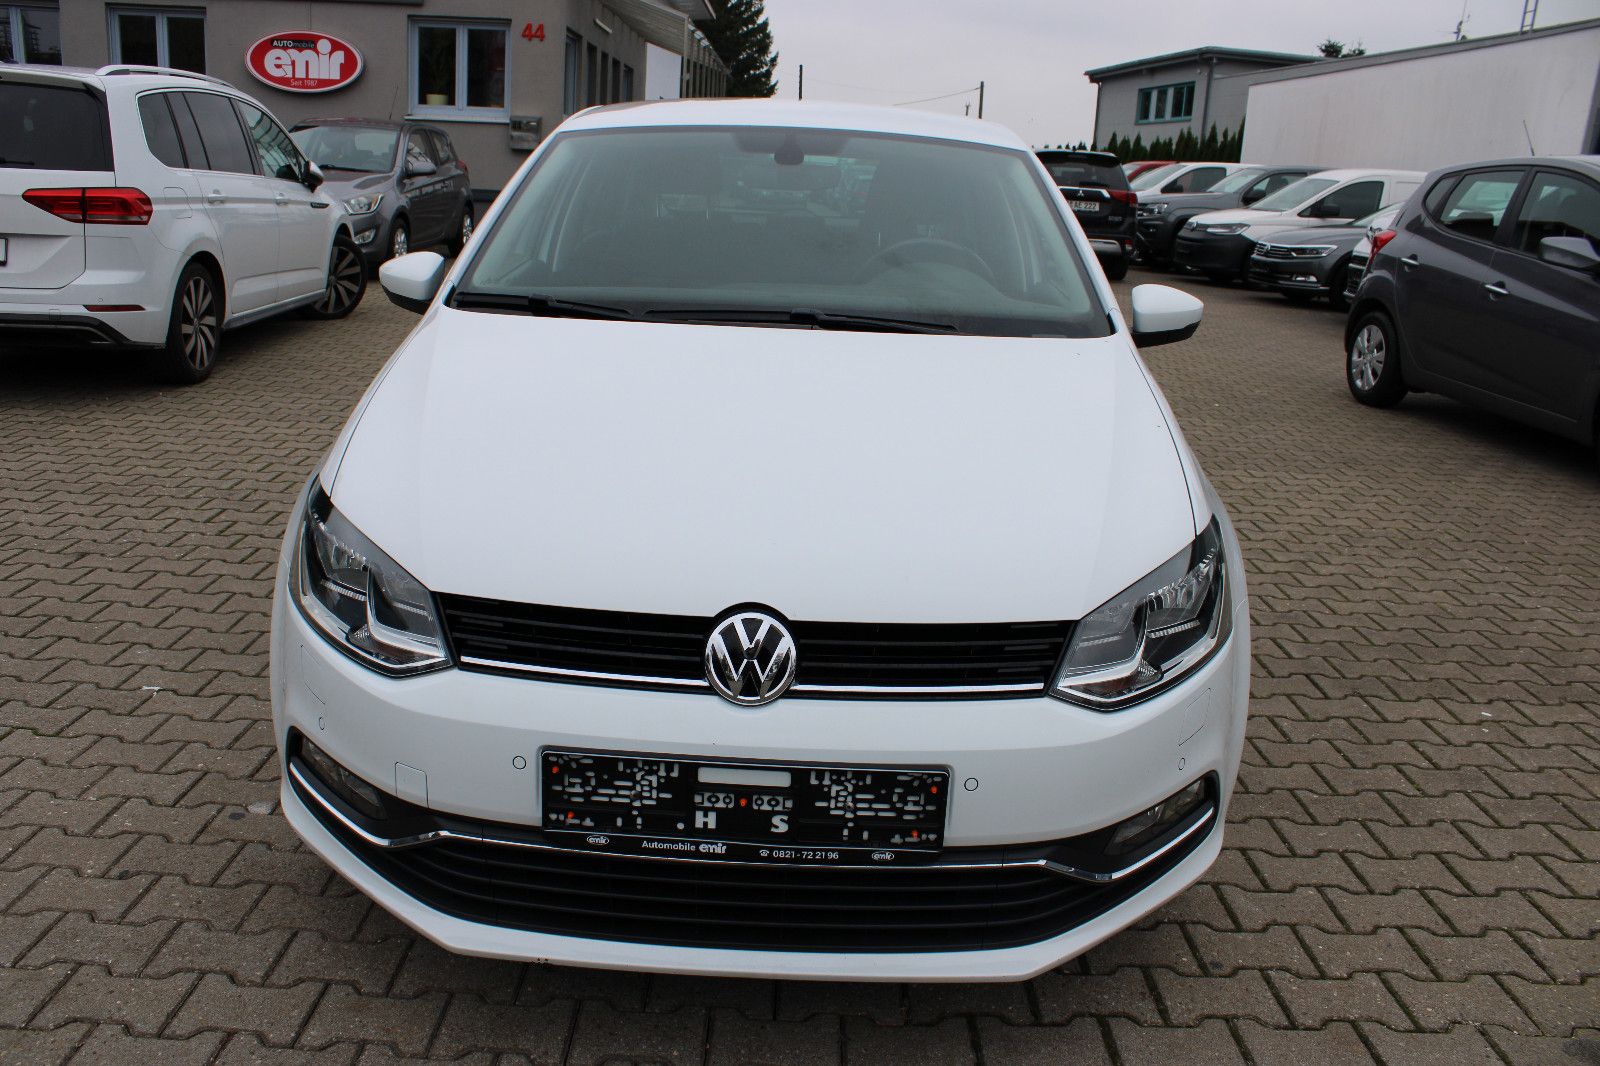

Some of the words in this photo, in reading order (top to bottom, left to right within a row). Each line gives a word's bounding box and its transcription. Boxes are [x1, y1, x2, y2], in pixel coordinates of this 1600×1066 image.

[521, 22, 545, 42] 44
[264, 39, 345, 80] emir
[290, 79, 302, 87] Seit
[304, 79, 318, 87] 1987
[641, 841, 696, 852] Automobile
[699, 842, 727, 854] emir
